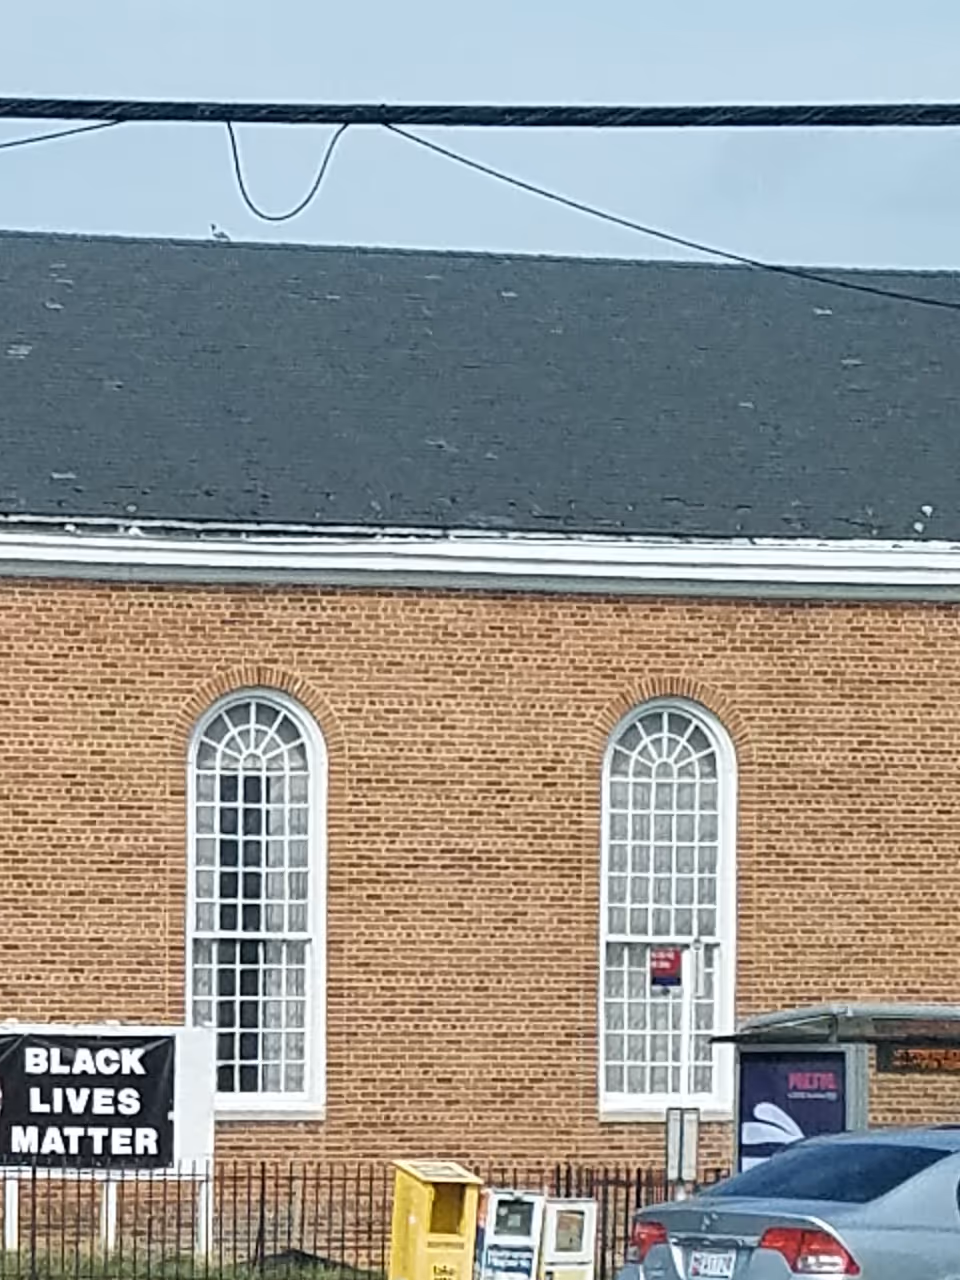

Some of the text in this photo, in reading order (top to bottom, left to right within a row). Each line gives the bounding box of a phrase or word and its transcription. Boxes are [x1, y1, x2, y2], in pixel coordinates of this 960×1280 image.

[24, 1047, 145, 1075] BLACK
[28, 1087, 141, 1115] LIVES
[10, 1126, 159, 1155] MATTER
